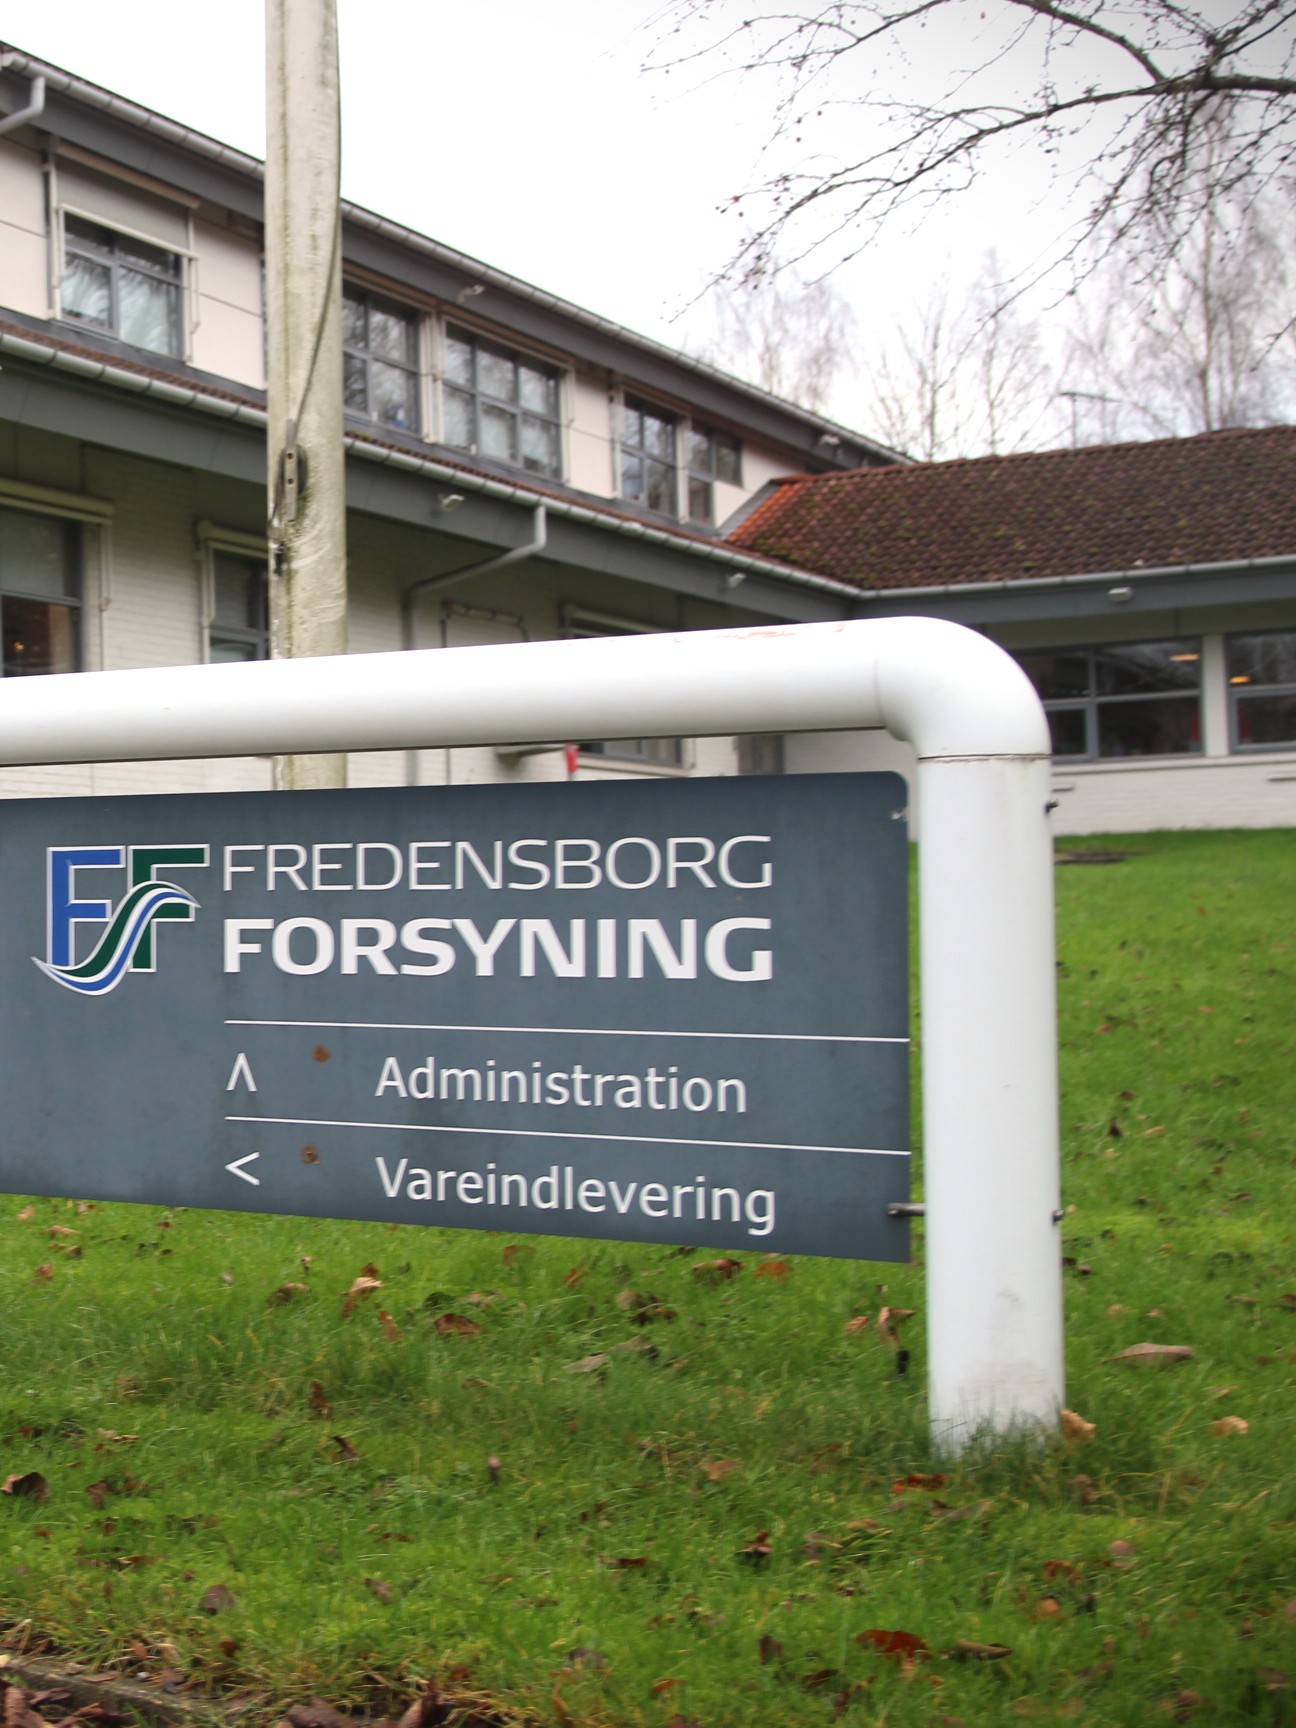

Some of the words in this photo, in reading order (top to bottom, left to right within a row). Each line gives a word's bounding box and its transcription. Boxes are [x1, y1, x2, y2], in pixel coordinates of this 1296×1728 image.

[222, 834, 773, 891] FREDENSBORG
[222, 916, 774, 982] FORSYNING
[374, 1055, 747, 1113] Administration
[375, 1155, 776, 1236] Vareindlevering
